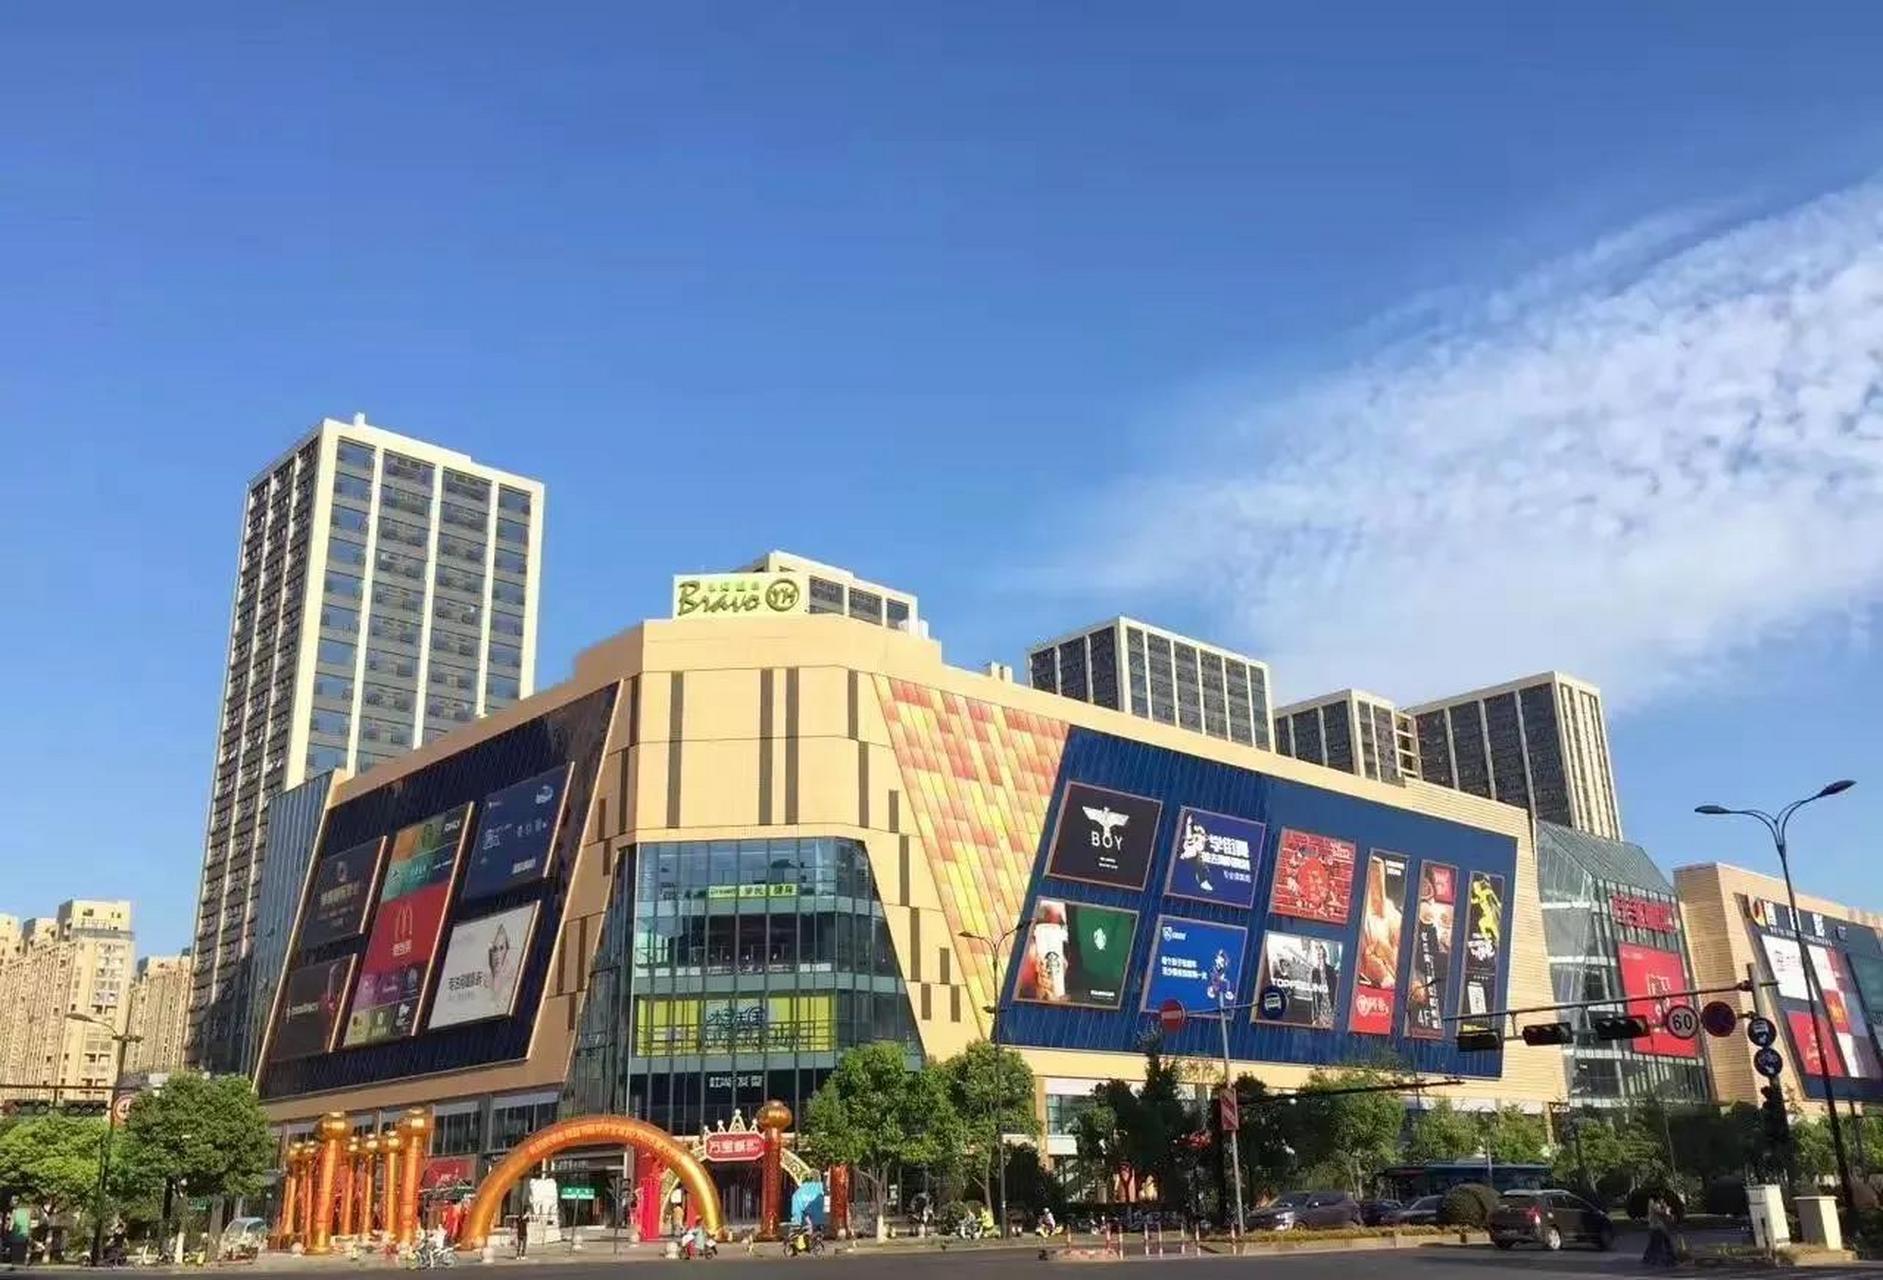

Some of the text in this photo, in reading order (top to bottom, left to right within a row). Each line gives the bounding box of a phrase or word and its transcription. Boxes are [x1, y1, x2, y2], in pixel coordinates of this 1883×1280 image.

[678, 580, 761, 616] Bravo
[1091, 832, 1124, 851] BOY
[1673, 1014, 1693, 1031] 60
